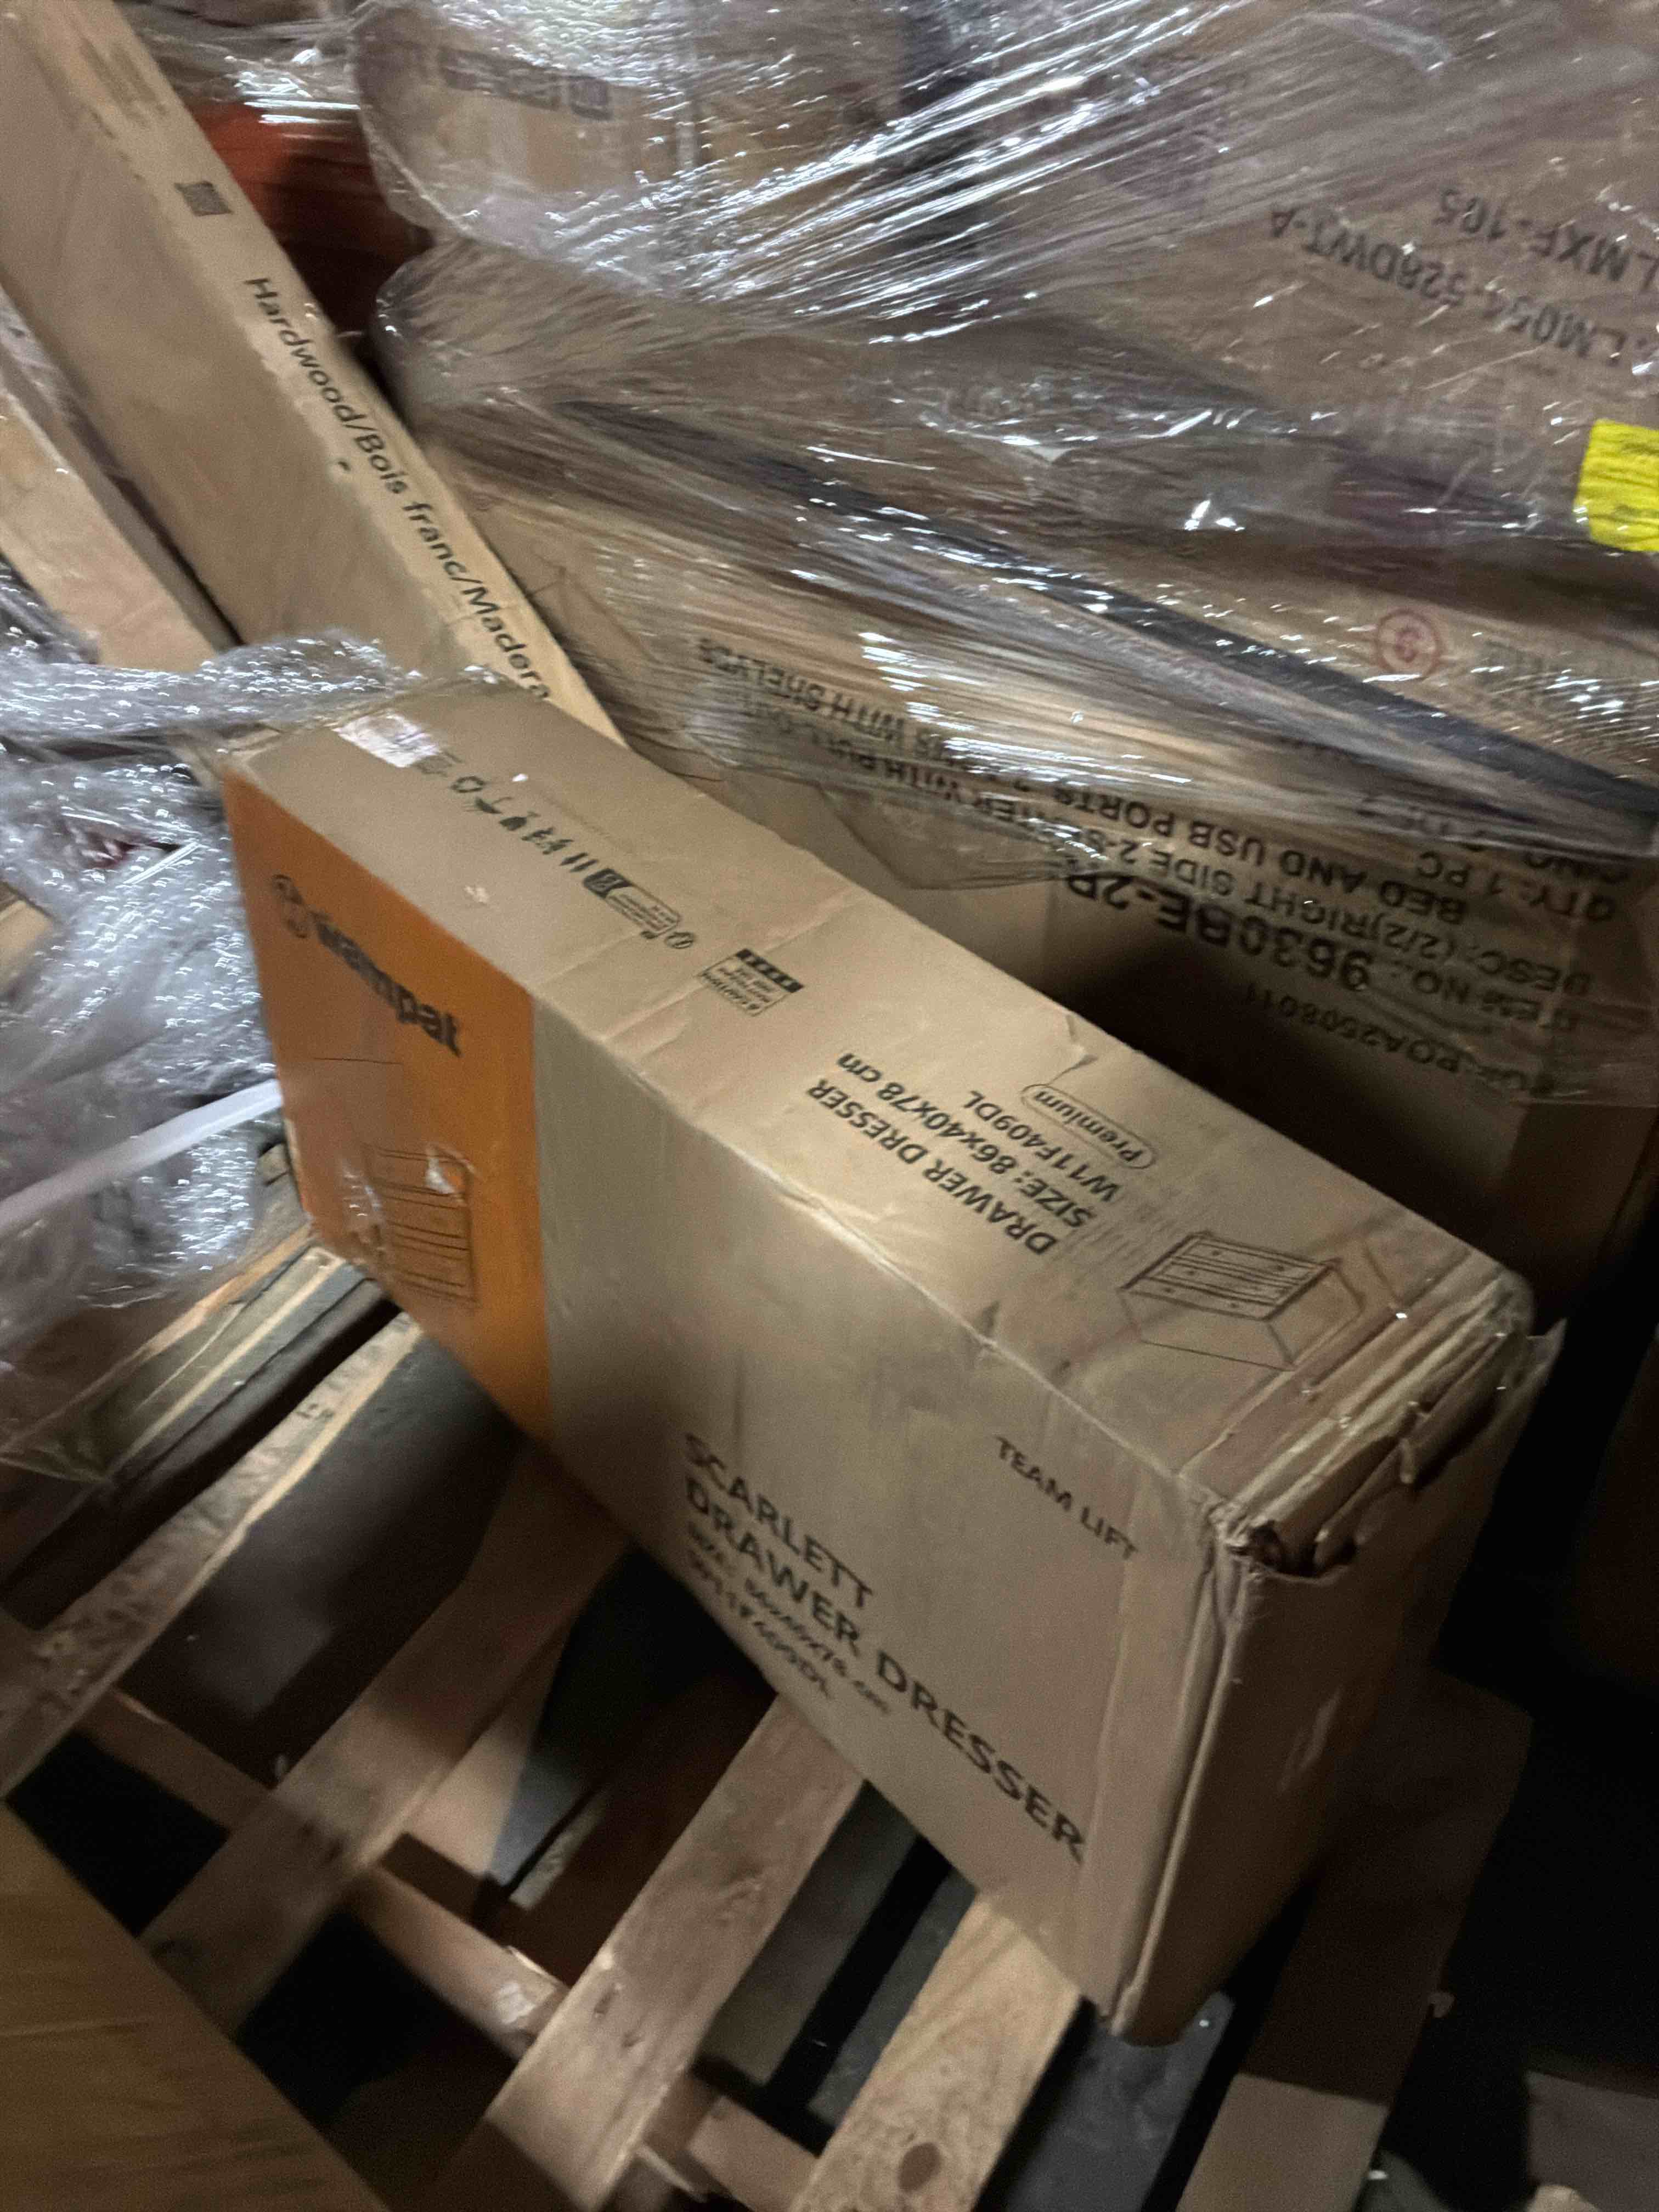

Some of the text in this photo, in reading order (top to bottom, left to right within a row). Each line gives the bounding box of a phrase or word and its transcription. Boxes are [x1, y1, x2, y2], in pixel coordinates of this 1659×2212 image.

[245, 276, 549, 699] Hardwood/Bois franc/Madera
[1150, 850, 1235, 895] SIDE
[1189, 821, 1266, 866] USB
[1278, 850, 1368, 893] AND
[1418, 851, 1472, 888] PC
[1379, 880, 1466, 924] BED
[807, 1079, 1061, 1255] DRAWER DRESSER
[837, 1053, 1095, 1229] SIZE: 86x40x78 cm
[962, 1090, 1124, 1202] W11F409DL
[1032, 1090, 1144, 1164] Premium
[685, 1432, 873, 1609] SCARLETT
[993, 1435, 1139, 1560] TEAM LIFT
[686, 1477, 1085, 1865] DRAWER DRESSER
